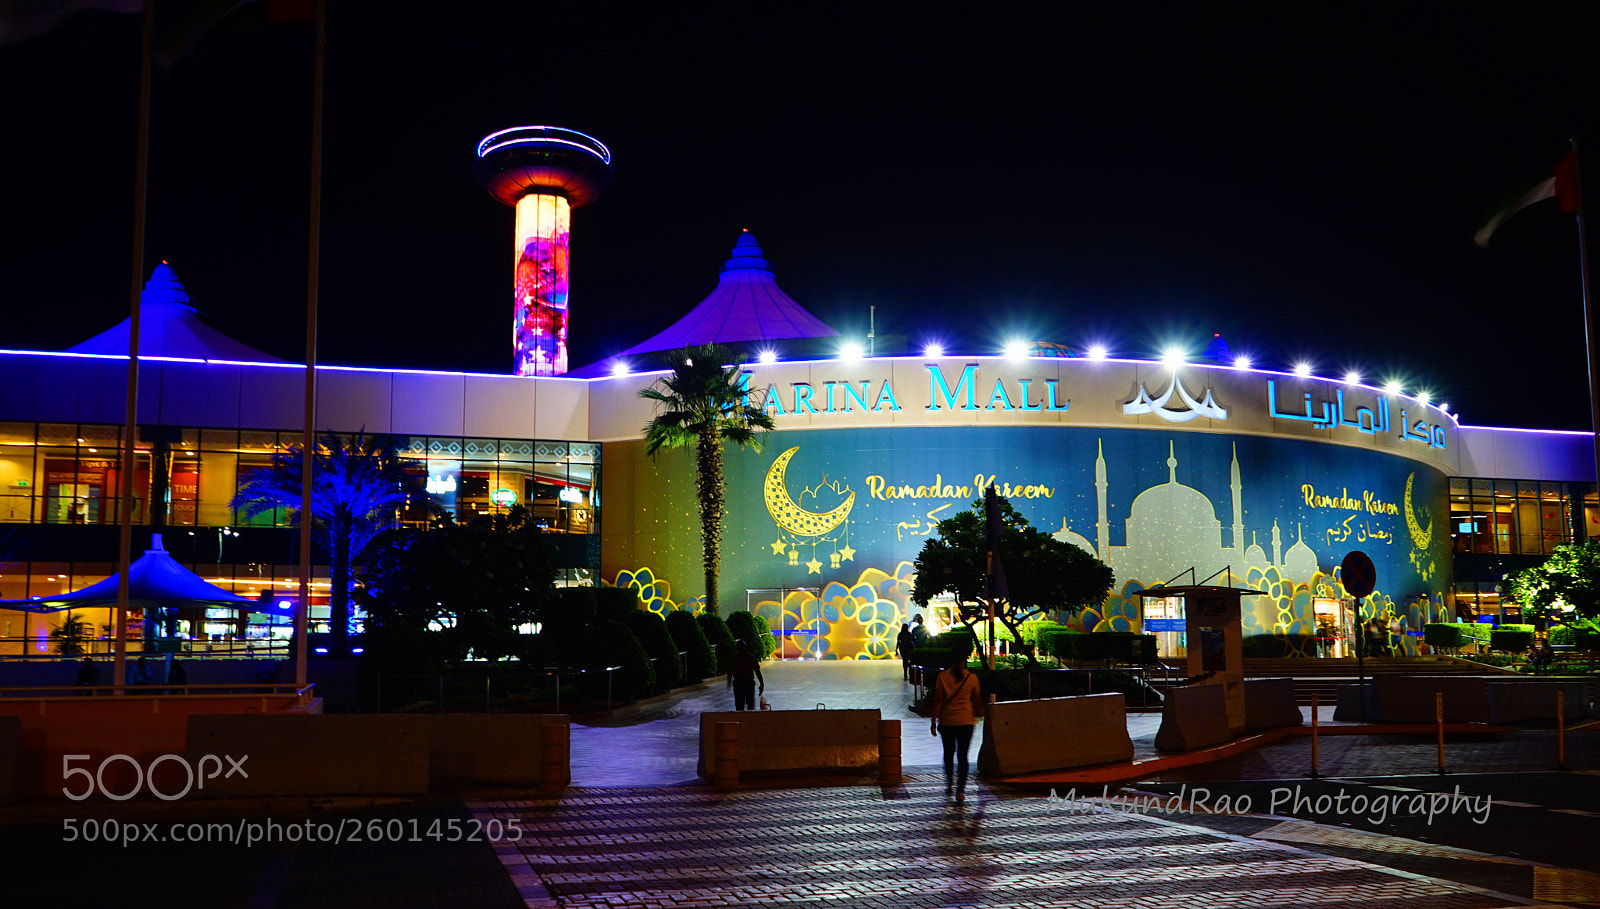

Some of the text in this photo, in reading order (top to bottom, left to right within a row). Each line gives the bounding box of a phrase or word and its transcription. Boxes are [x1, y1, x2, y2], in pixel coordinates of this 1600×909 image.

[925, 364, 1071, 412] MALL
[1268, 380, 1447, 449] مركز المارينا
[174, 484, 197, 494] TIME
[865, 474, 1056, 501] Ramadan Kareem
[1301, 484, 1400, 516] Ramadan Kareem
[897, 503, 953, 542] كريم
[1326, 514, 1393, 546] رمضان كريم
